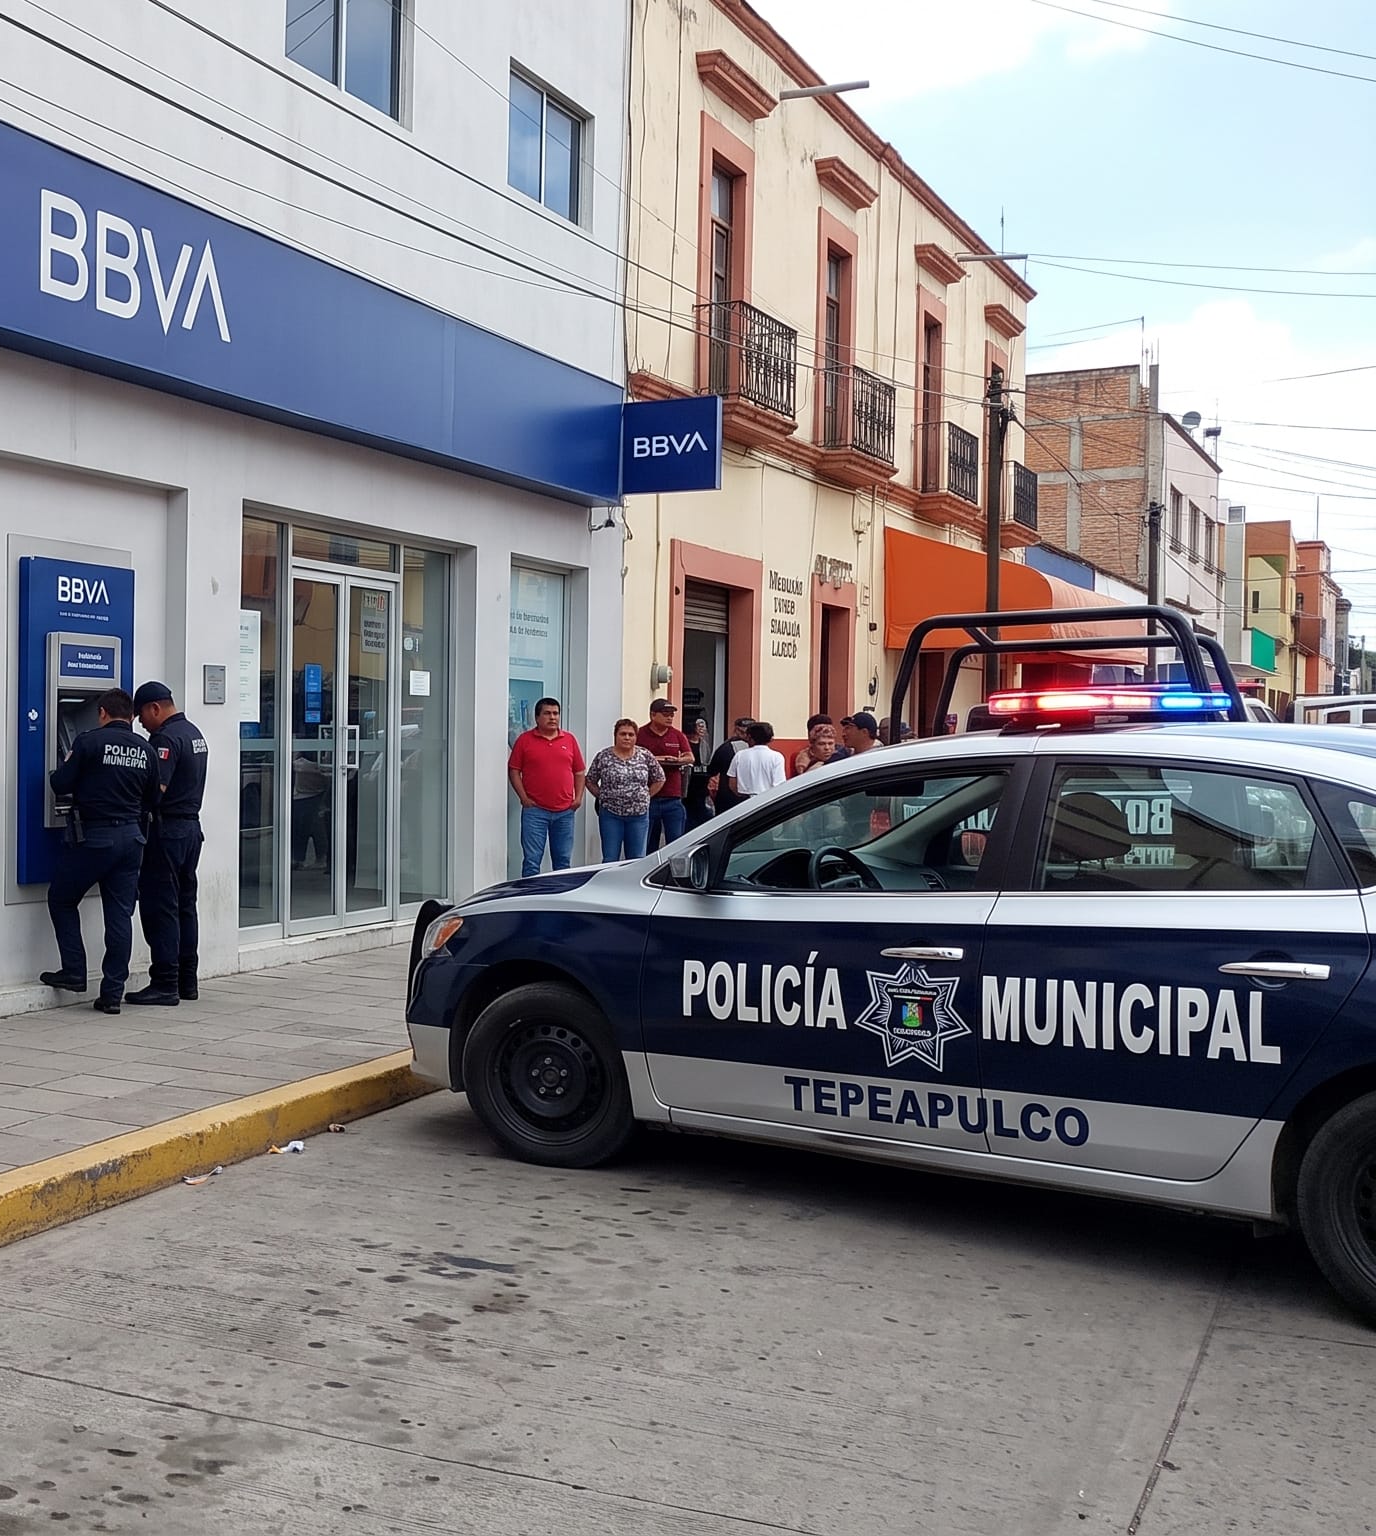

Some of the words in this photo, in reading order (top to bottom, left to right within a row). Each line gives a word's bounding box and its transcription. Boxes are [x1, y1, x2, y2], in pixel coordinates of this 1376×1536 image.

[40, 188, 231, 343] BBVA
[633, 431, 708, 458] BBVA
[57, 576, 110, 605] BBVA
[682, 951, 848, 1030] POLICÍA
[982, 975, 1281, 1065] MUNICIPAL
[784, 1075, 1090, 1147] TEPEAPULCO
